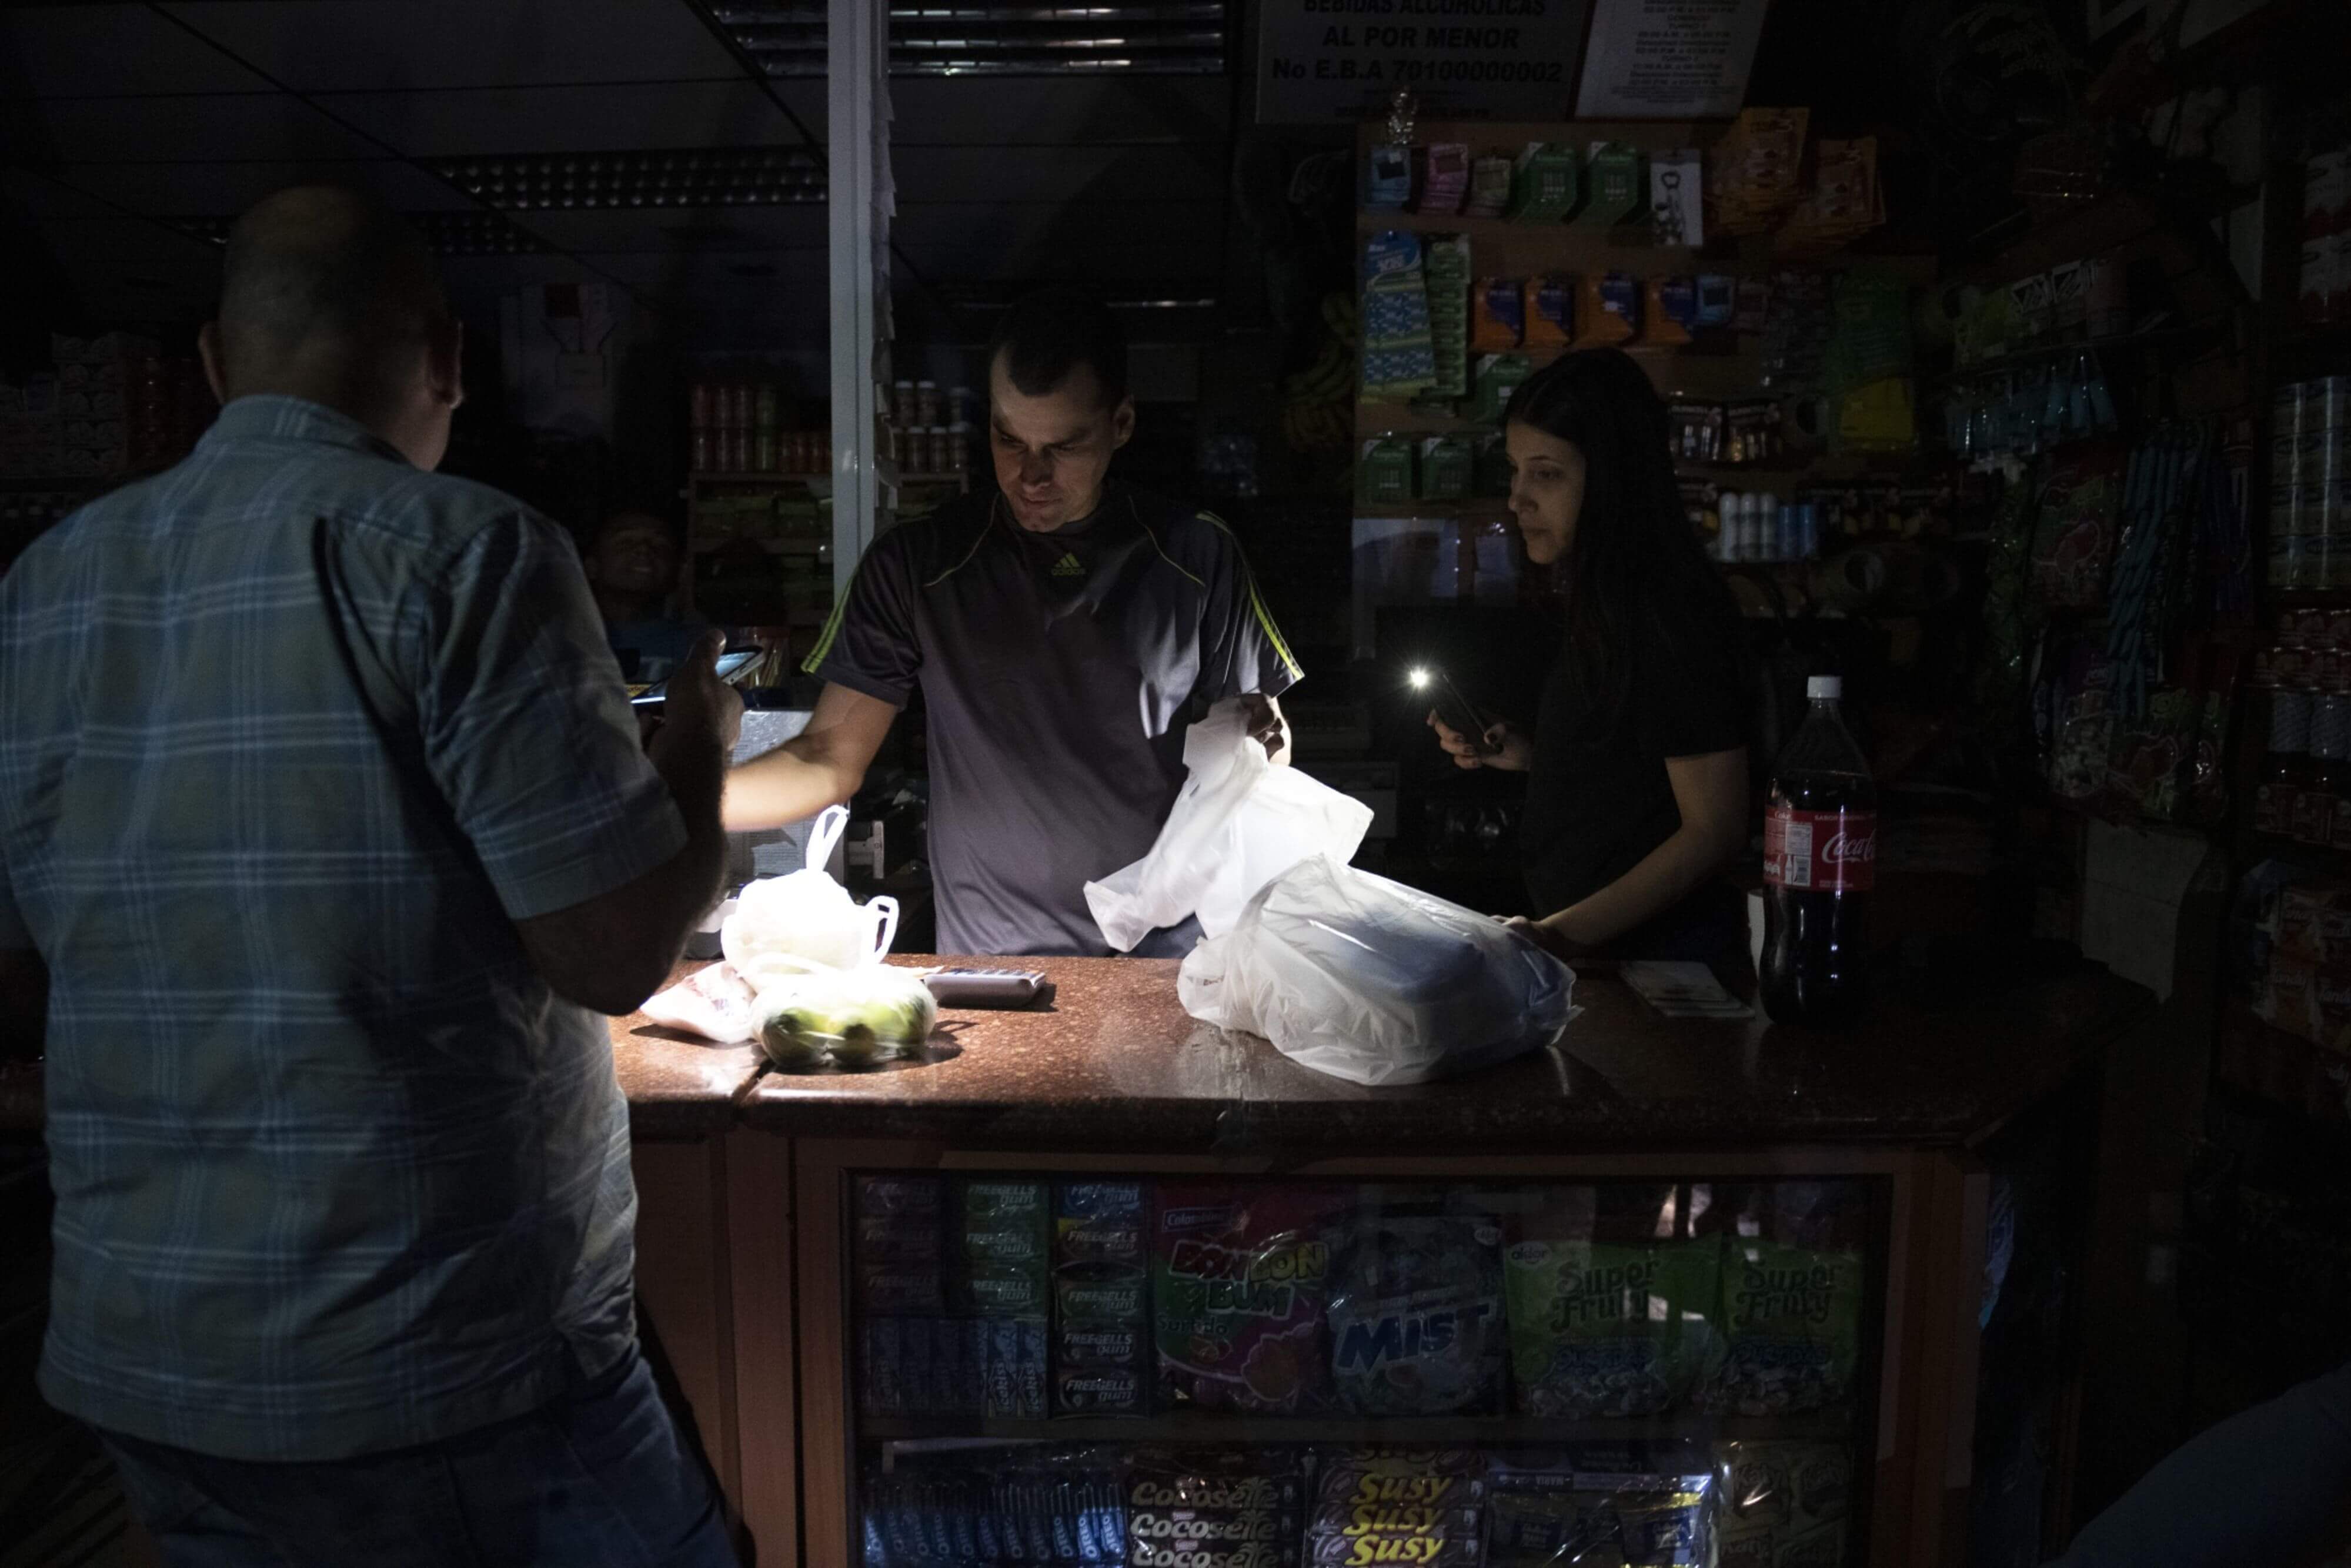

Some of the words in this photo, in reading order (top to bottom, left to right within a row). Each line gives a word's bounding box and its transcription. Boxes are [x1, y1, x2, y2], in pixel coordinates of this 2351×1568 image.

[1304, 0, 1393, 14] BEBIDAS
[1400, 0, 1547, 16] ALCOHOLICAS
[1323, 26, 1355, 47] AL
[1364, 26, 1417, 48] POR
[1425, 27, 1520, 49] MENOR
[1271, 58, 1307, 80] No
[1314, 59, 1383, 80] E.B.A
[1172, 1241, 1249, 1281] BON
[1250, 1243, 1327, 1282] BON
[1511, 1247, 1549, 1264] aldor
[1557, 1258, 1659, 1292] Super
[1744, 1260, 1844, 1293] Super
[1207, 1281, 1293, 1318] BUM
[1064, 1332, 1134, 1345] FREEGELLS
[1157, 1315, 1228, 1336] Surtido
[1337, 1302, 1491, 1372] MIST
[1065, 1379, 1135, 1392] FREEGELLS
[1130, 1476, 1281, 1509] Cocosette
[1352, 1473, 1451, 1505] Susy
[1128, 1509, 1280, 1539] Cocosette
[1342, 1503, 1447, 1536] Susy
[1128, 1539, 1280, 1568] Cocosette
[1343, 1534, 1447, 1567] Susy
